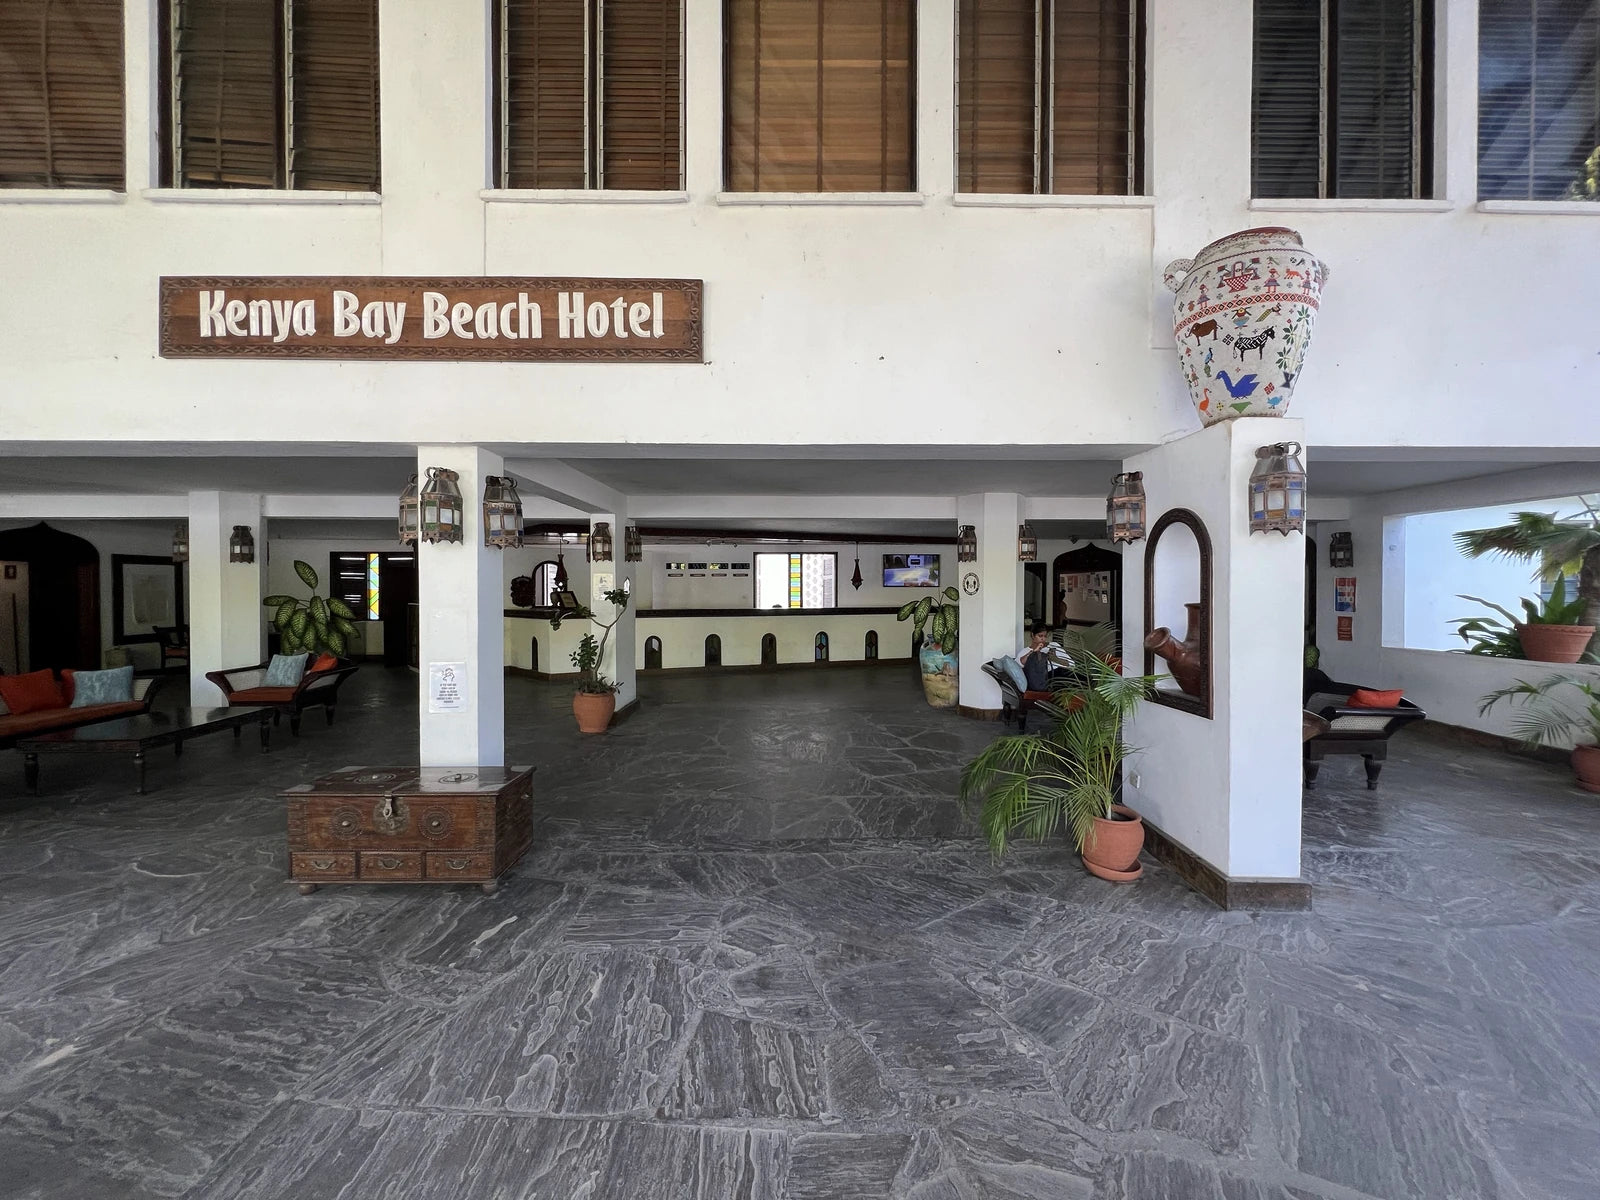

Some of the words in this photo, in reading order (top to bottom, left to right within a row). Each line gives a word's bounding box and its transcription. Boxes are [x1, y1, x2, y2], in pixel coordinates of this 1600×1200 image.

[200, 290, 316, 342] Kenya
[333, 291, 406, 344] Bay
[422, 291, 541, 340] Beach
[558, 292, 665, 340] Hotel
